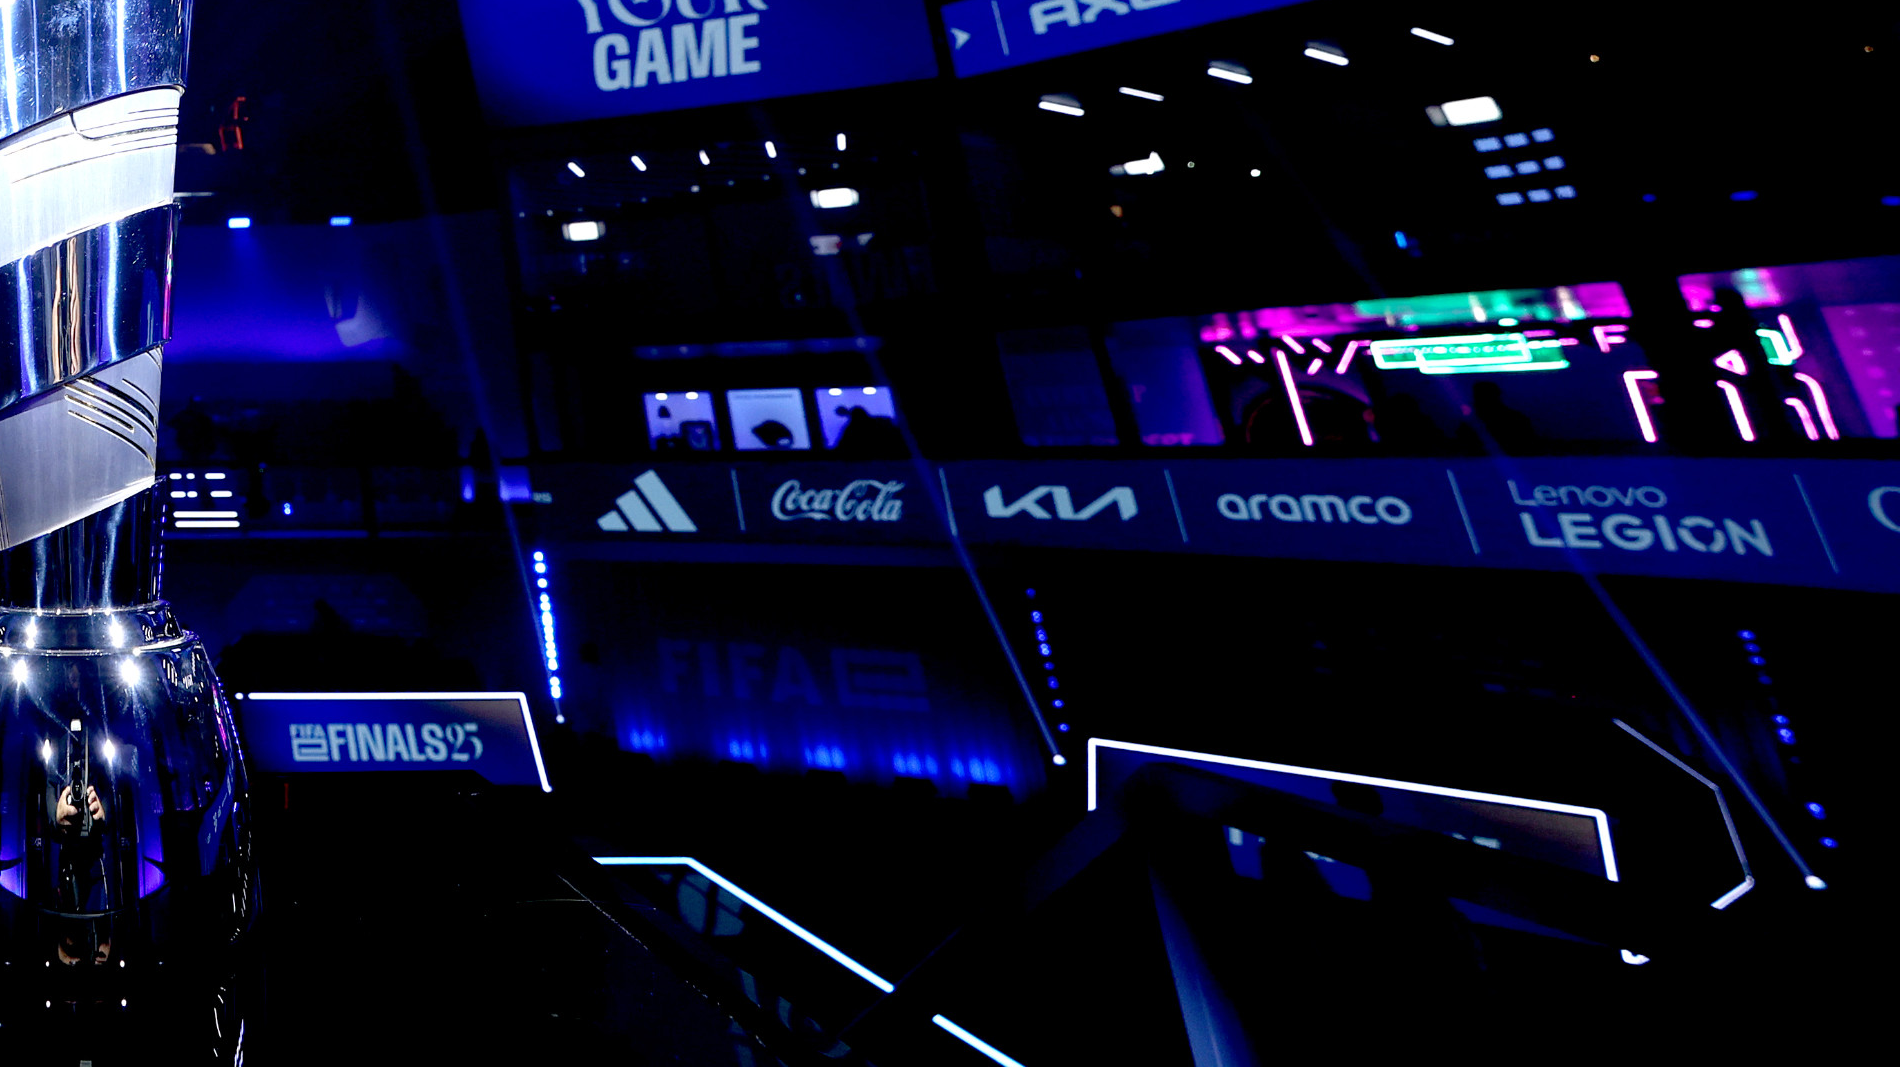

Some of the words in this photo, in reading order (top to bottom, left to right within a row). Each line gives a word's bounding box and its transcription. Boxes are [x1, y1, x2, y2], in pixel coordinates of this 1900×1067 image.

[592, 12, 762, 92] GAME
[771, 479, 905, 522] Coca-Cola
[1217, 493, 1413, 525] aramco
[1507, 479, 1667, 509] Lenovo
[1519, 512, 1773, 557] LEGION
